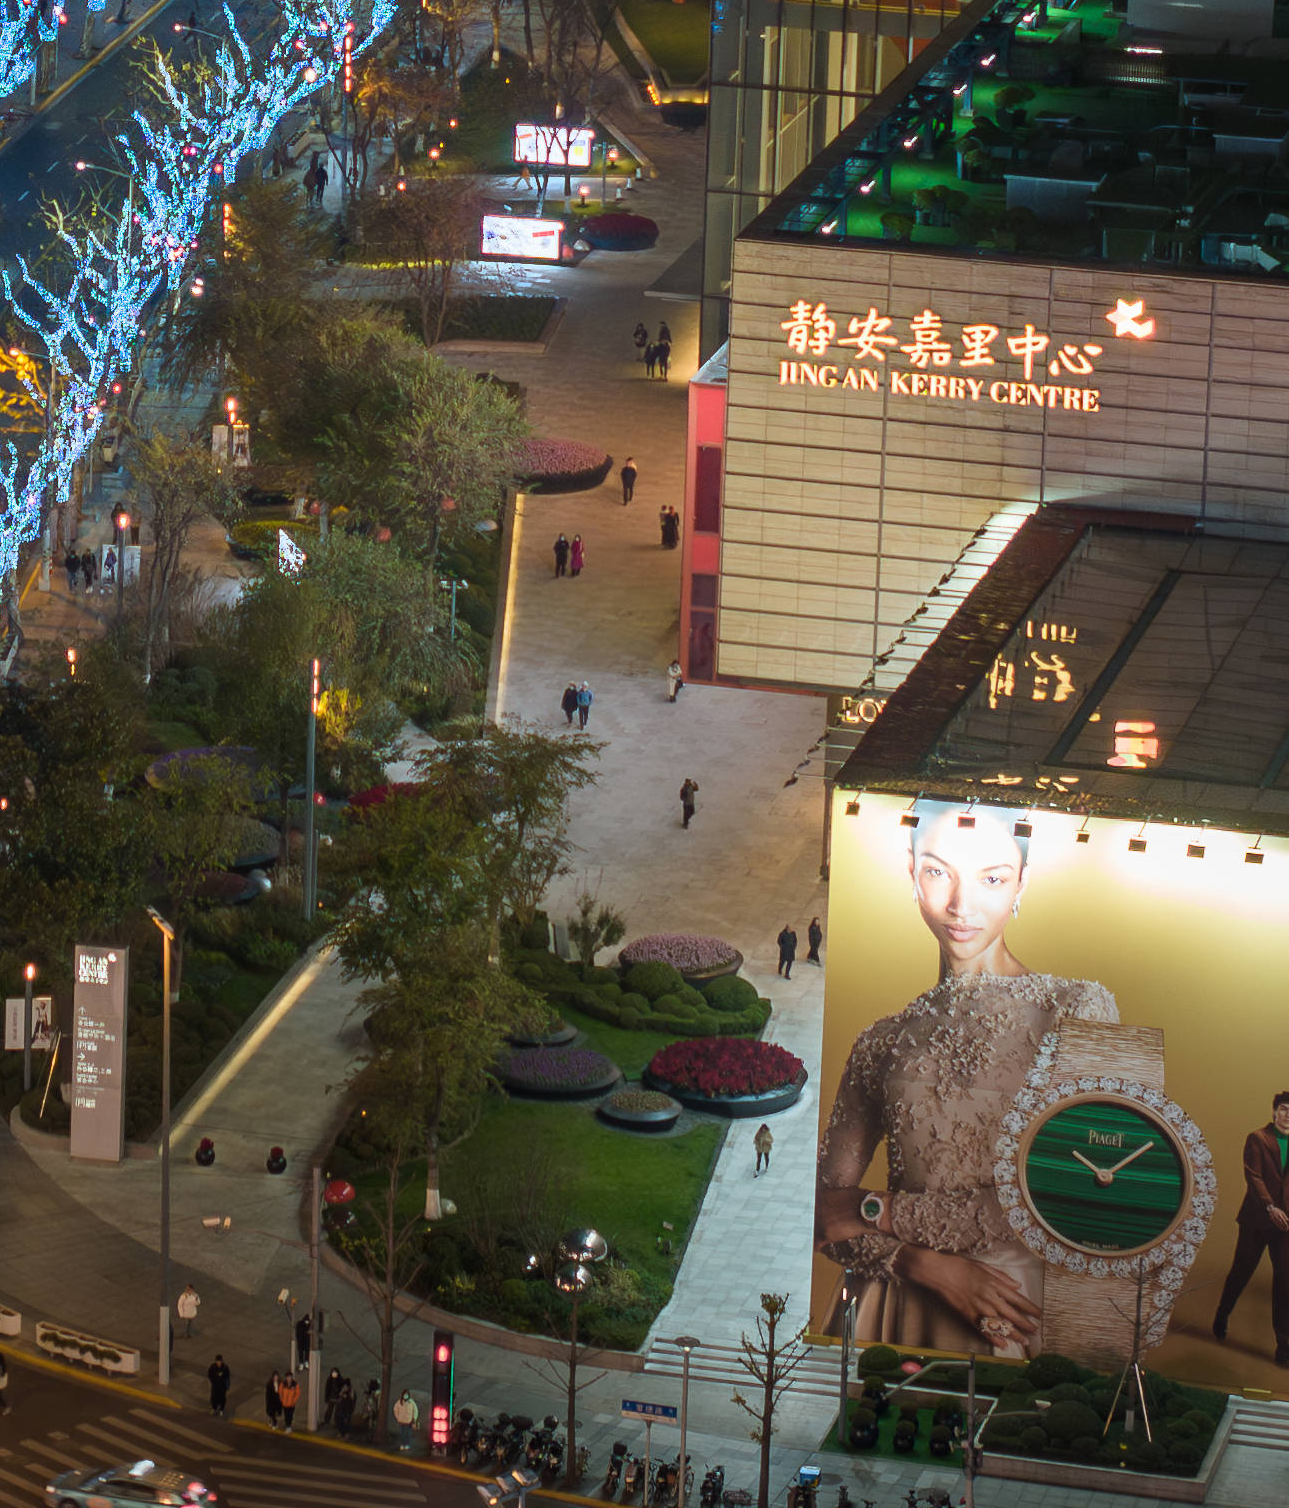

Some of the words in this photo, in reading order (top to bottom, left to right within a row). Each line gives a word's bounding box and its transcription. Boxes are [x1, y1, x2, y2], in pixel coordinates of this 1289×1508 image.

[780, 299, 1103, 379] 静安嘉里中心
[779, 361, 837, 388] JING
[843, 368, 879, 391] AN
[890, 372, 985, 401] KERRY
[990, 382, 1100, 413] CENTRE
[1088, 1129, 1126, 1148] PIAGET
